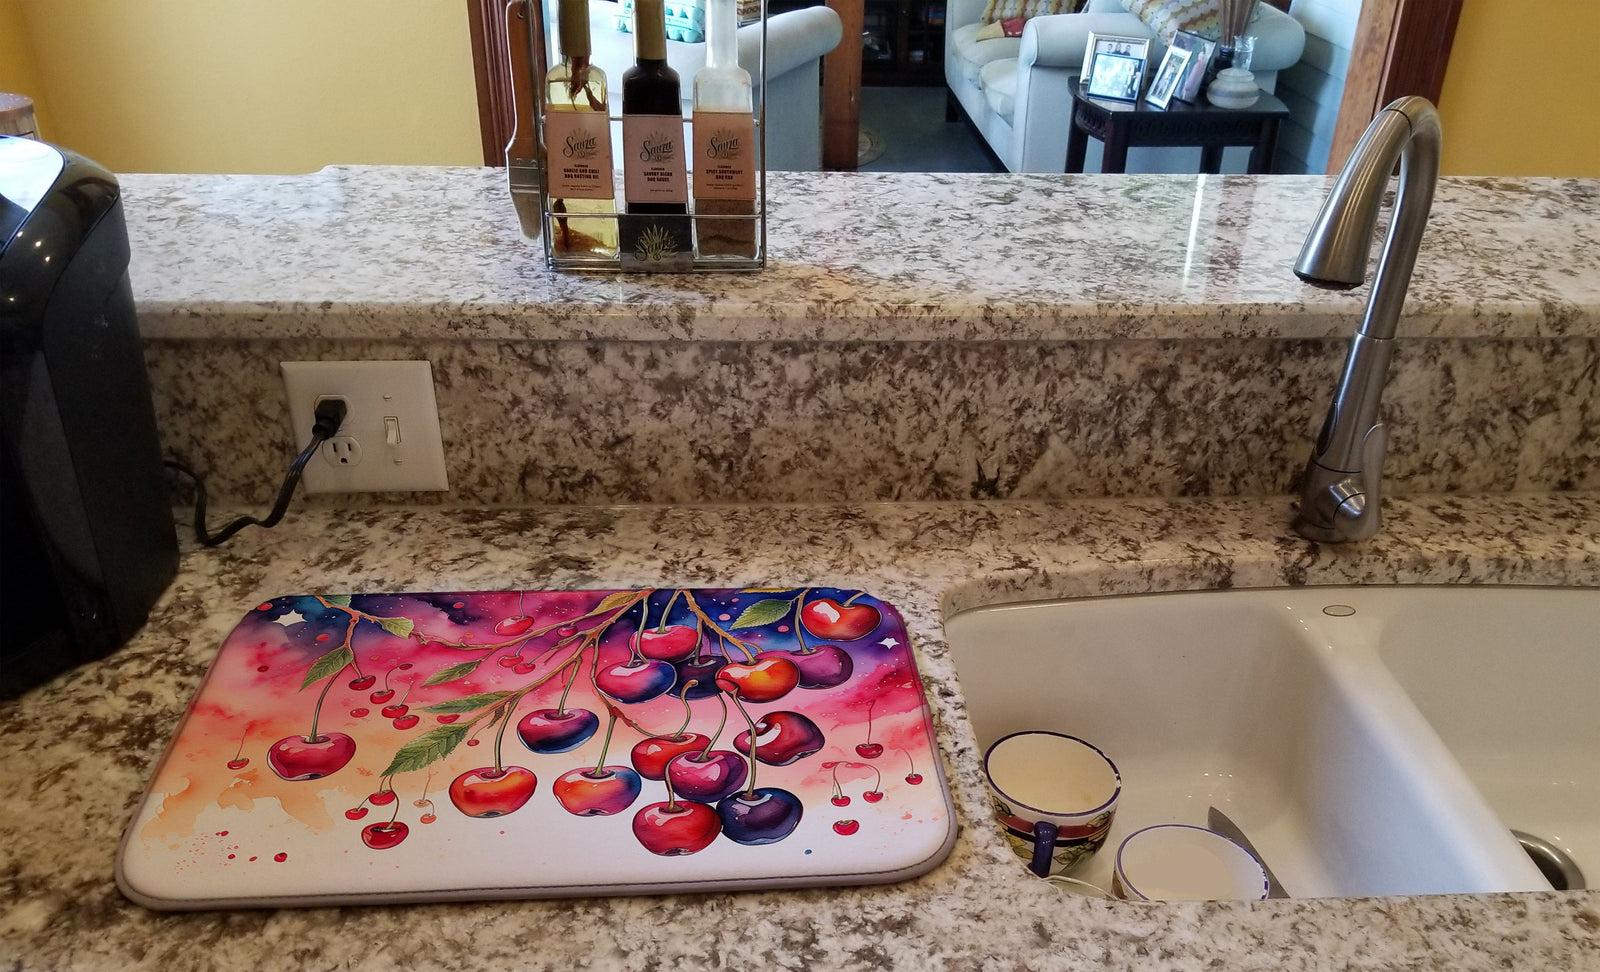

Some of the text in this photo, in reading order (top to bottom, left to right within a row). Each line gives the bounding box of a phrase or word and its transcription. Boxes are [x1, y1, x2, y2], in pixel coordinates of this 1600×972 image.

[562, 136, 598, 158] Sauza
[640, 140, 674, 162] Sauza
[706, 136, 740, 159] Sauza
